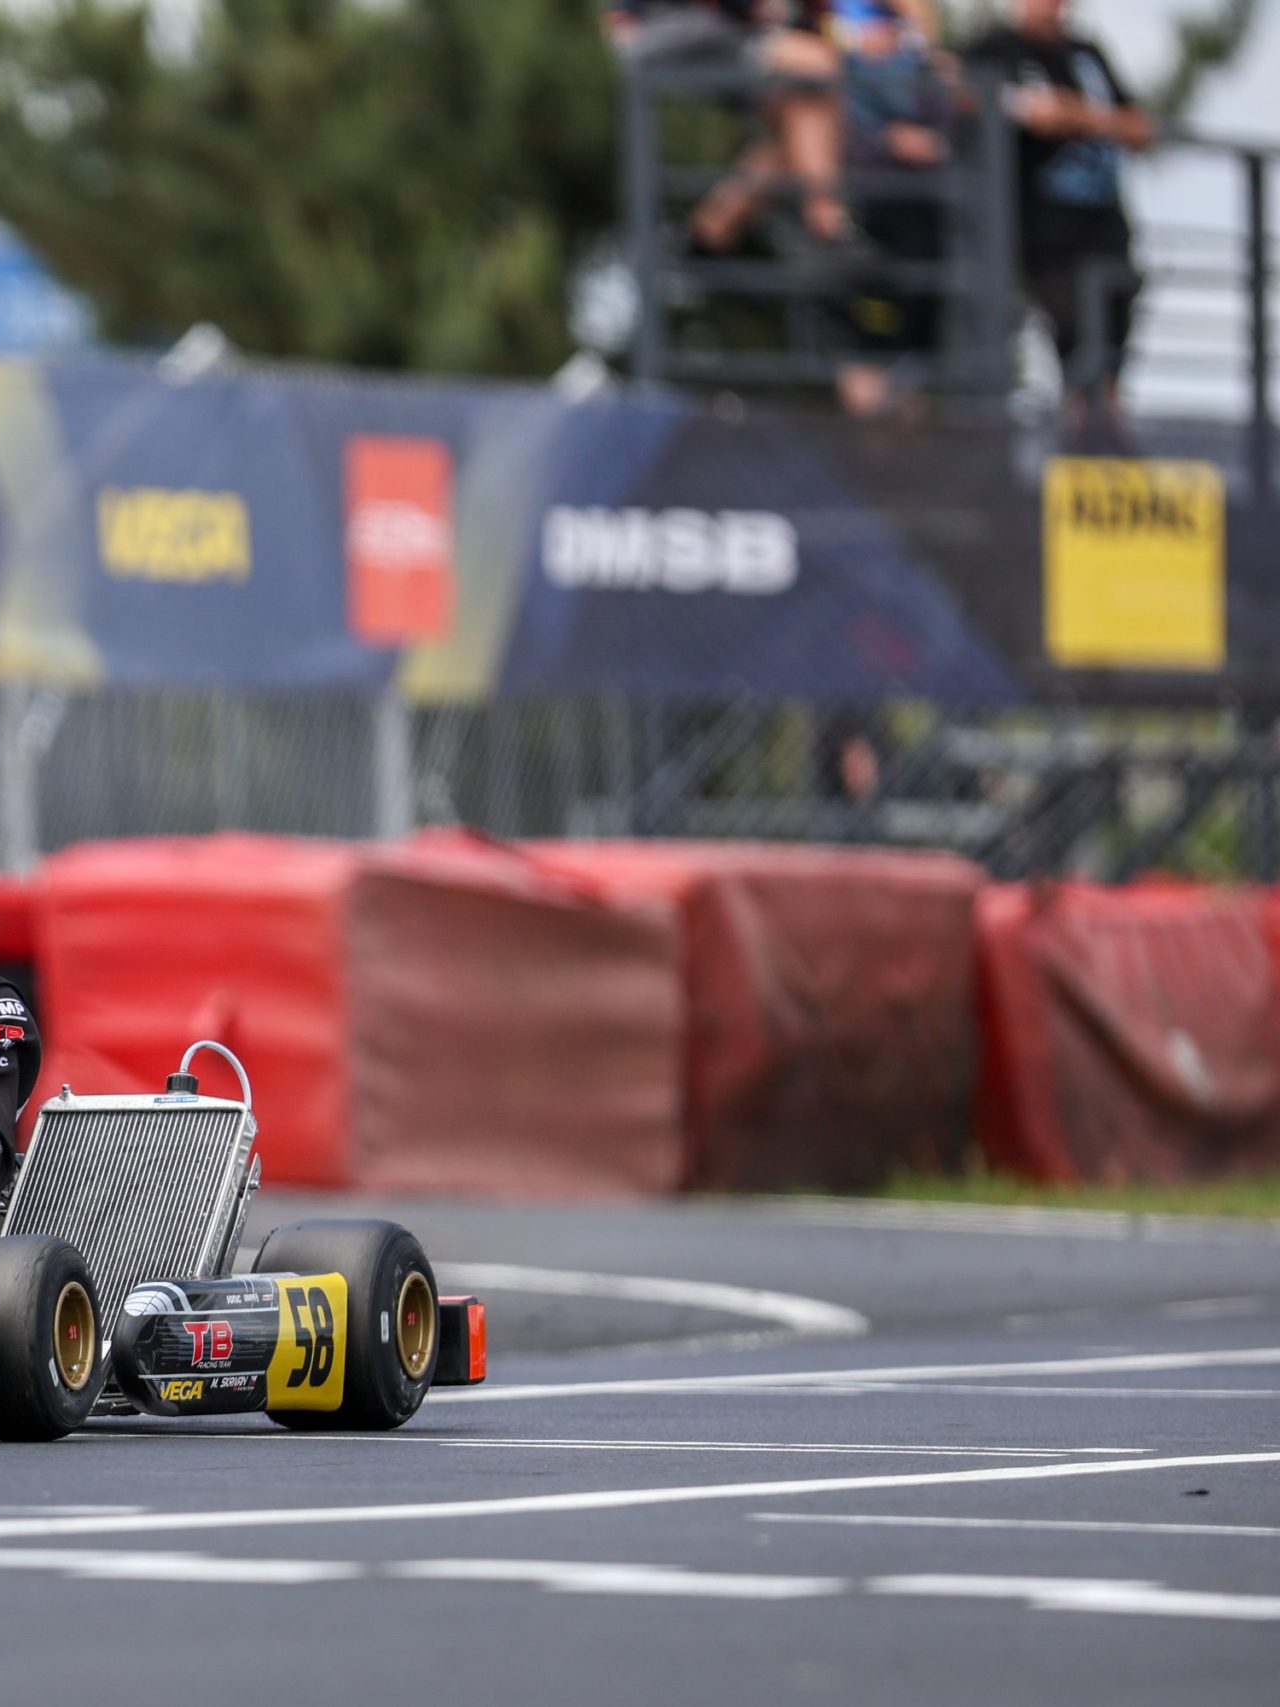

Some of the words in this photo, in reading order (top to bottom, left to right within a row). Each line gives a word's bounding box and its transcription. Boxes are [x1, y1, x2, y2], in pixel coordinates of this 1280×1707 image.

[182, 1320, 234, 1367] TB
[285, 1287, 335, 1388] 58
[197, 1361, 218, 1369] RACING
[160, 1380, 204, 1400] VEGA
